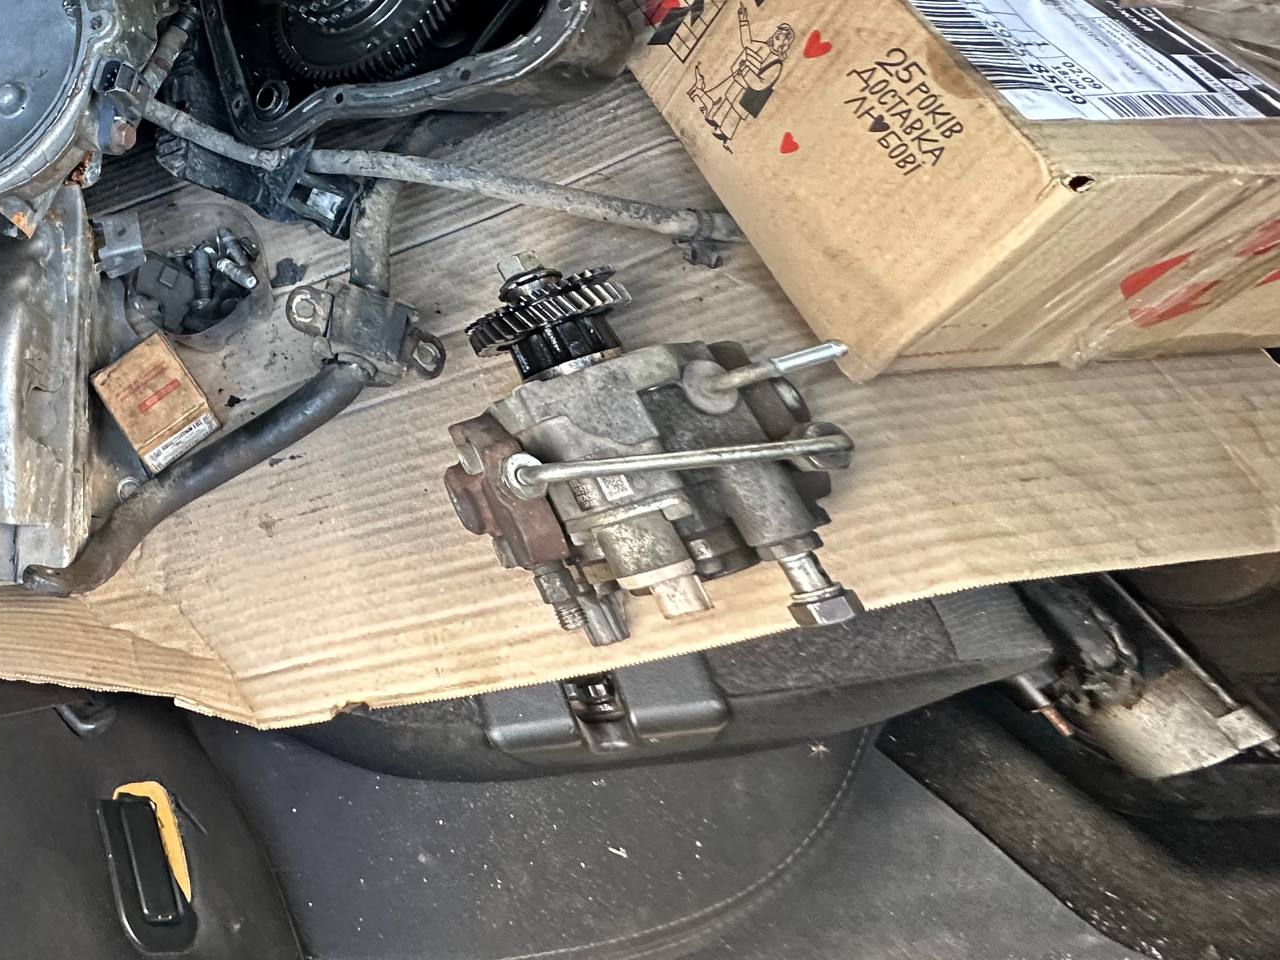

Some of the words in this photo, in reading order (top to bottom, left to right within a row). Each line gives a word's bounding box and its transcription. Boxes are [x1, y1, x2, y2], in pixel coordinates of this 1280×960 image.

[874, 47, 927, 84] 25
[905, 80, 964, 139] РОКІВ
[1028, 63, 1088, 105] 8509
[1051, 65, 1087, 90] 18:00
[1061, 61, 1103, 89] 02.09
[846, 66, 945, 167] ДОСТАВКА
